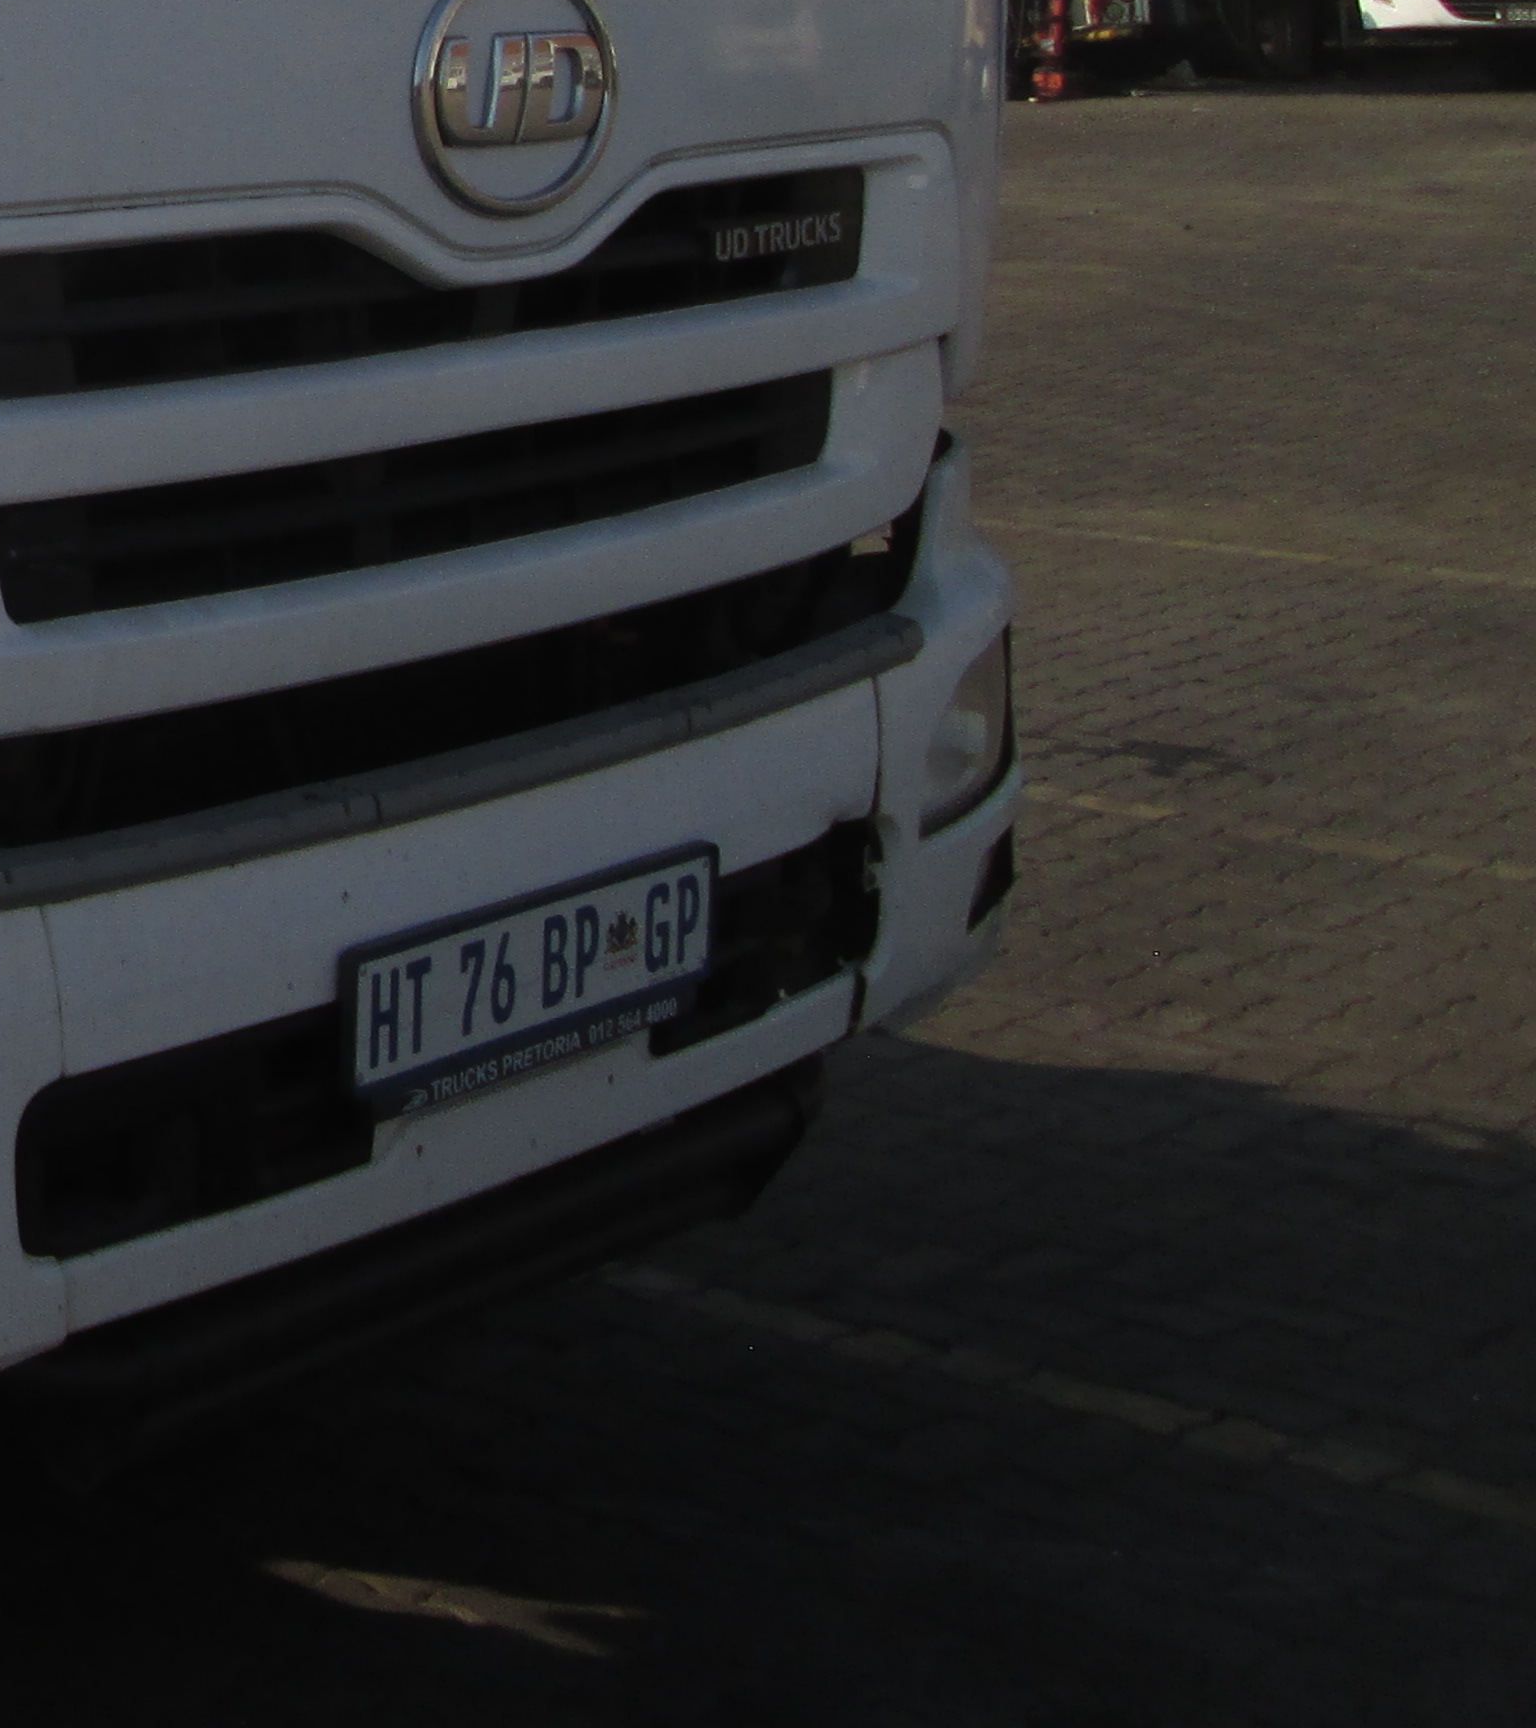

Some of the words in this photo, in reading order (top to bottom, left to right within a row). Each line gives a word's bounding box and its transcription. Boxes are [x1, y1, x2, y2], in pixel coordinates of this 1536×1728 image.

[437, 30, 604, 148] UD
[716, 226, 748, 261] UD
[753, 212, 843, 252] TRUCKS
[369, 956, 432, 1069] HT
[459, 932, 517, 1036] 76
[541, 904, 601, 1010] BP
[643, 874, 700, 973] GP
[430, 1059, 499, 1103] TRUCKS
[502, 1031, 581, 1076] PRETORIA
